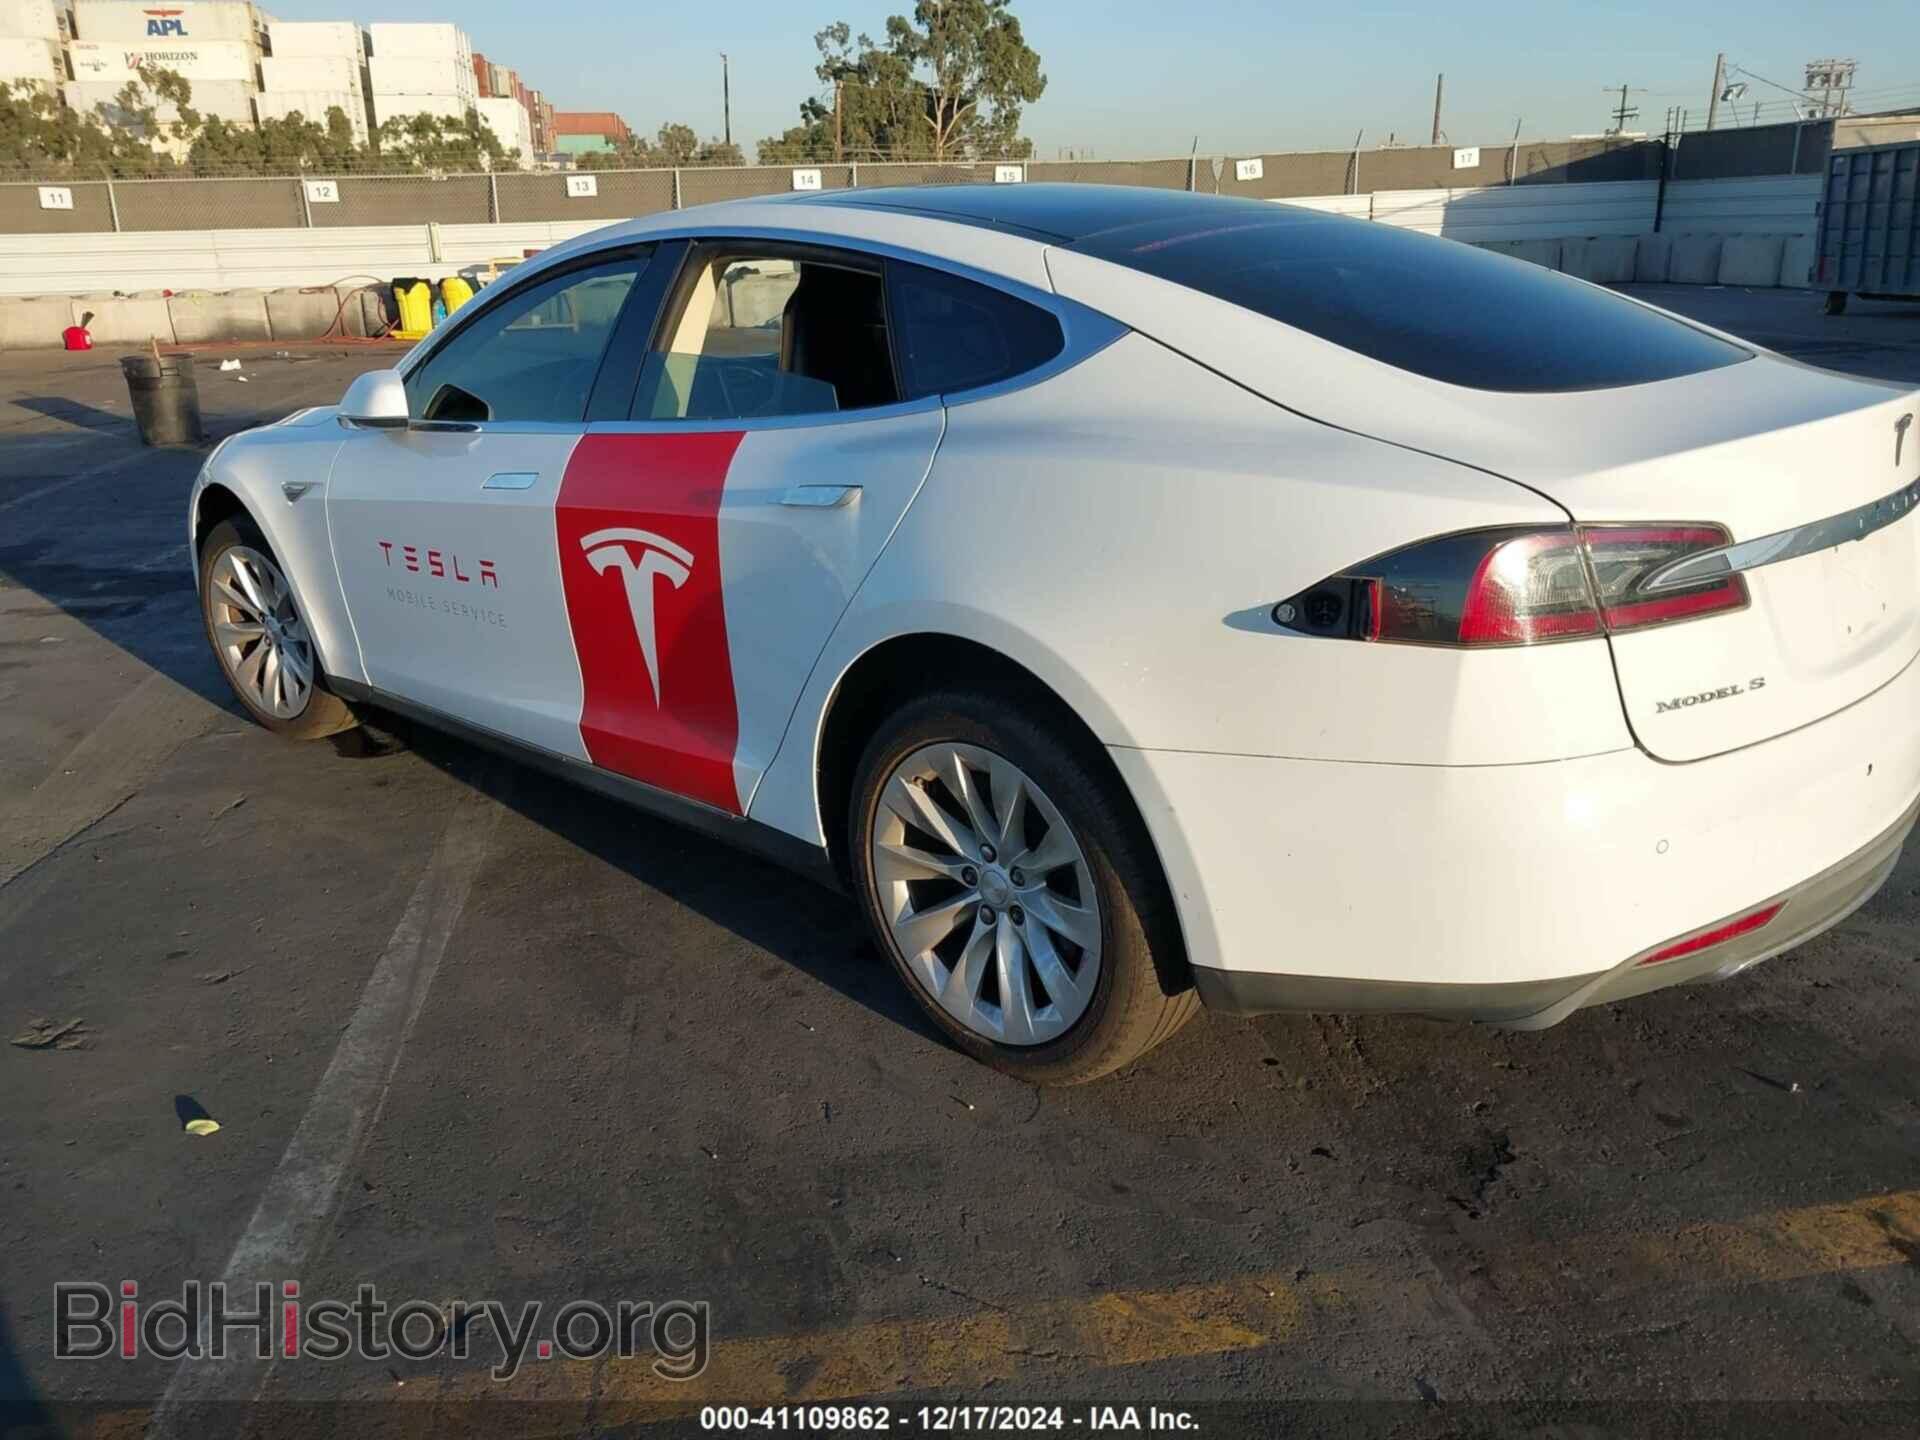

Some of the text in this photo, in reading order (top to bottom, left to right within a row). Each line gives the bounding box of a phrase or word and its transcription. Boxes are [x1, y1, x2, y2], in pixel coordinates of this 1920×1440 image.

[147, 19, 188, 36] APL
[144, 51, 198, 61] HORIZON
[1460, 152, 1473, 163] 17
[1243, 165, 1257, 175] 16
[801, 175, 815, 185] 14
[1002, 171, 1016, 182] 15
[315, 186, 331, 198] 12
[575, 181, 590, 192] 13
[49, 193, 64, 204] 11
[379, 541, 498, 589] TESLA
[386, 586, 507, 629] MOBILE SERVICE
[1656, 677, 1766, 714] MODEL S
